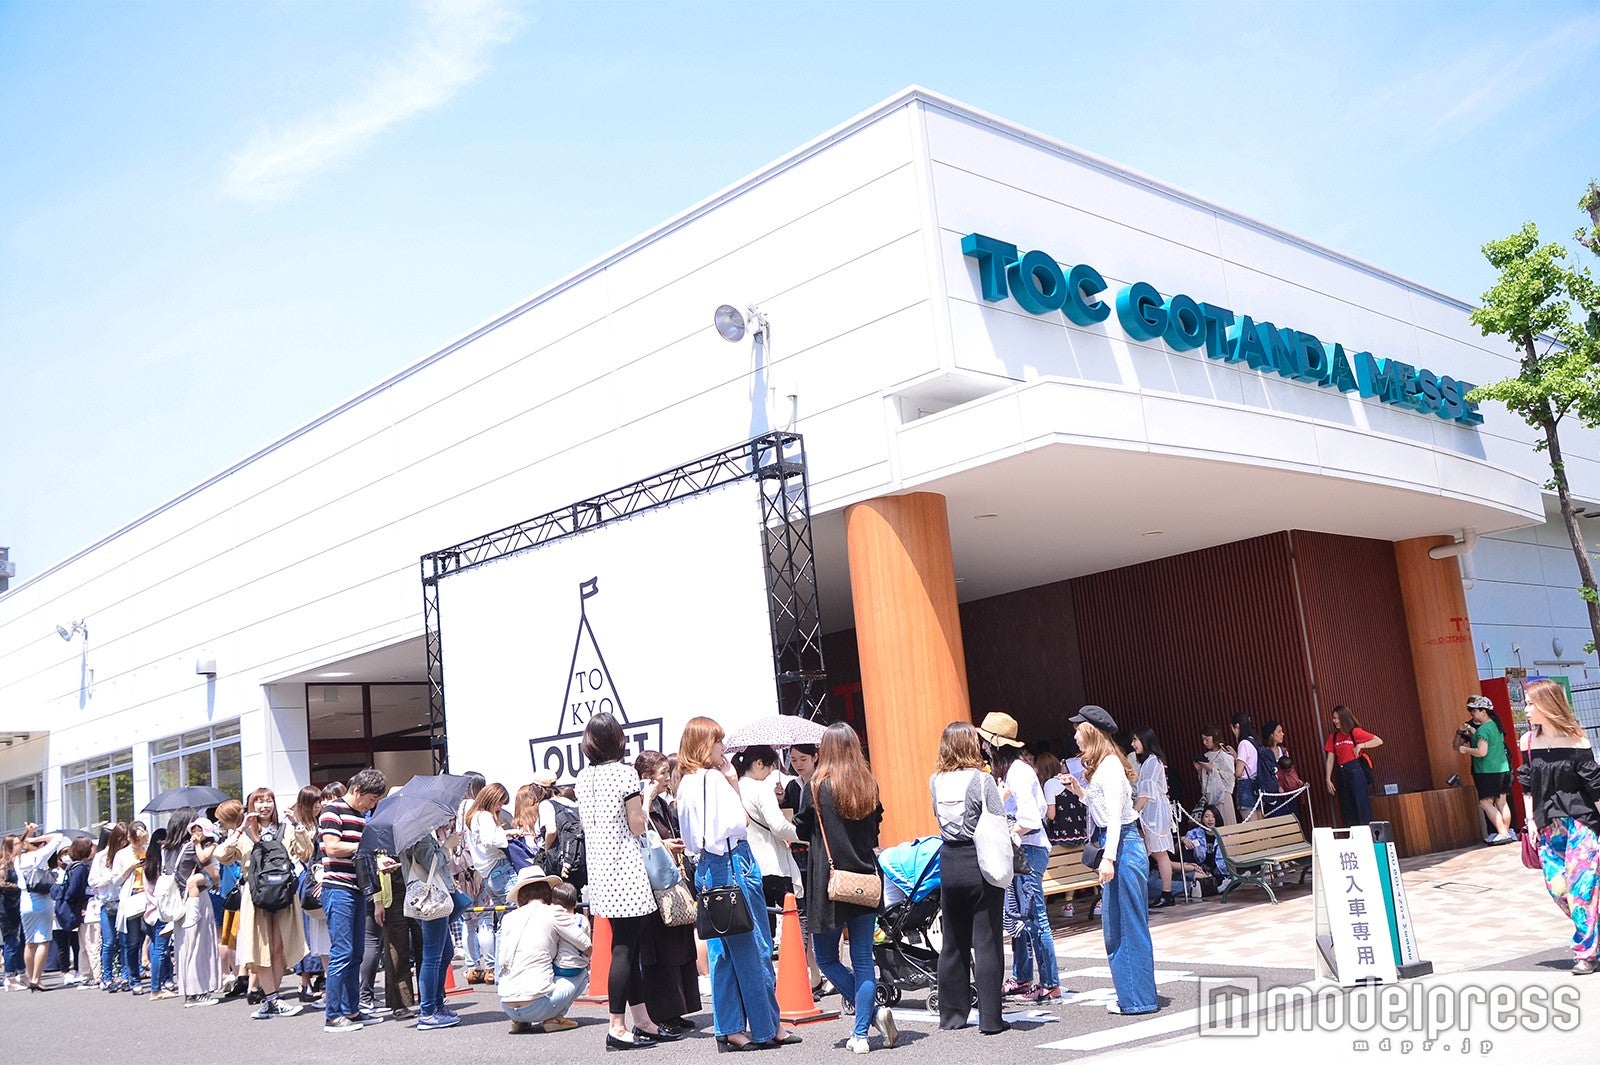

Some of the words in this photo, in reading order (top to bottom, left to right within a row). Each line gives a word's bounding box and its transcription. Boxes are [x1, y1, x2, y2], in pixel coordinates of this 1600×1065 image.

[961, 232, 1111, 327] TOC
[1115, 281, 1358, 394] GOTANDA
[1354, 351, 1485, 427] MESSE
[571, 697, 614, 726] KYO
[575, 668, 603, 694] TO
[1338, 851, 1376, 966] 搬入車専用
